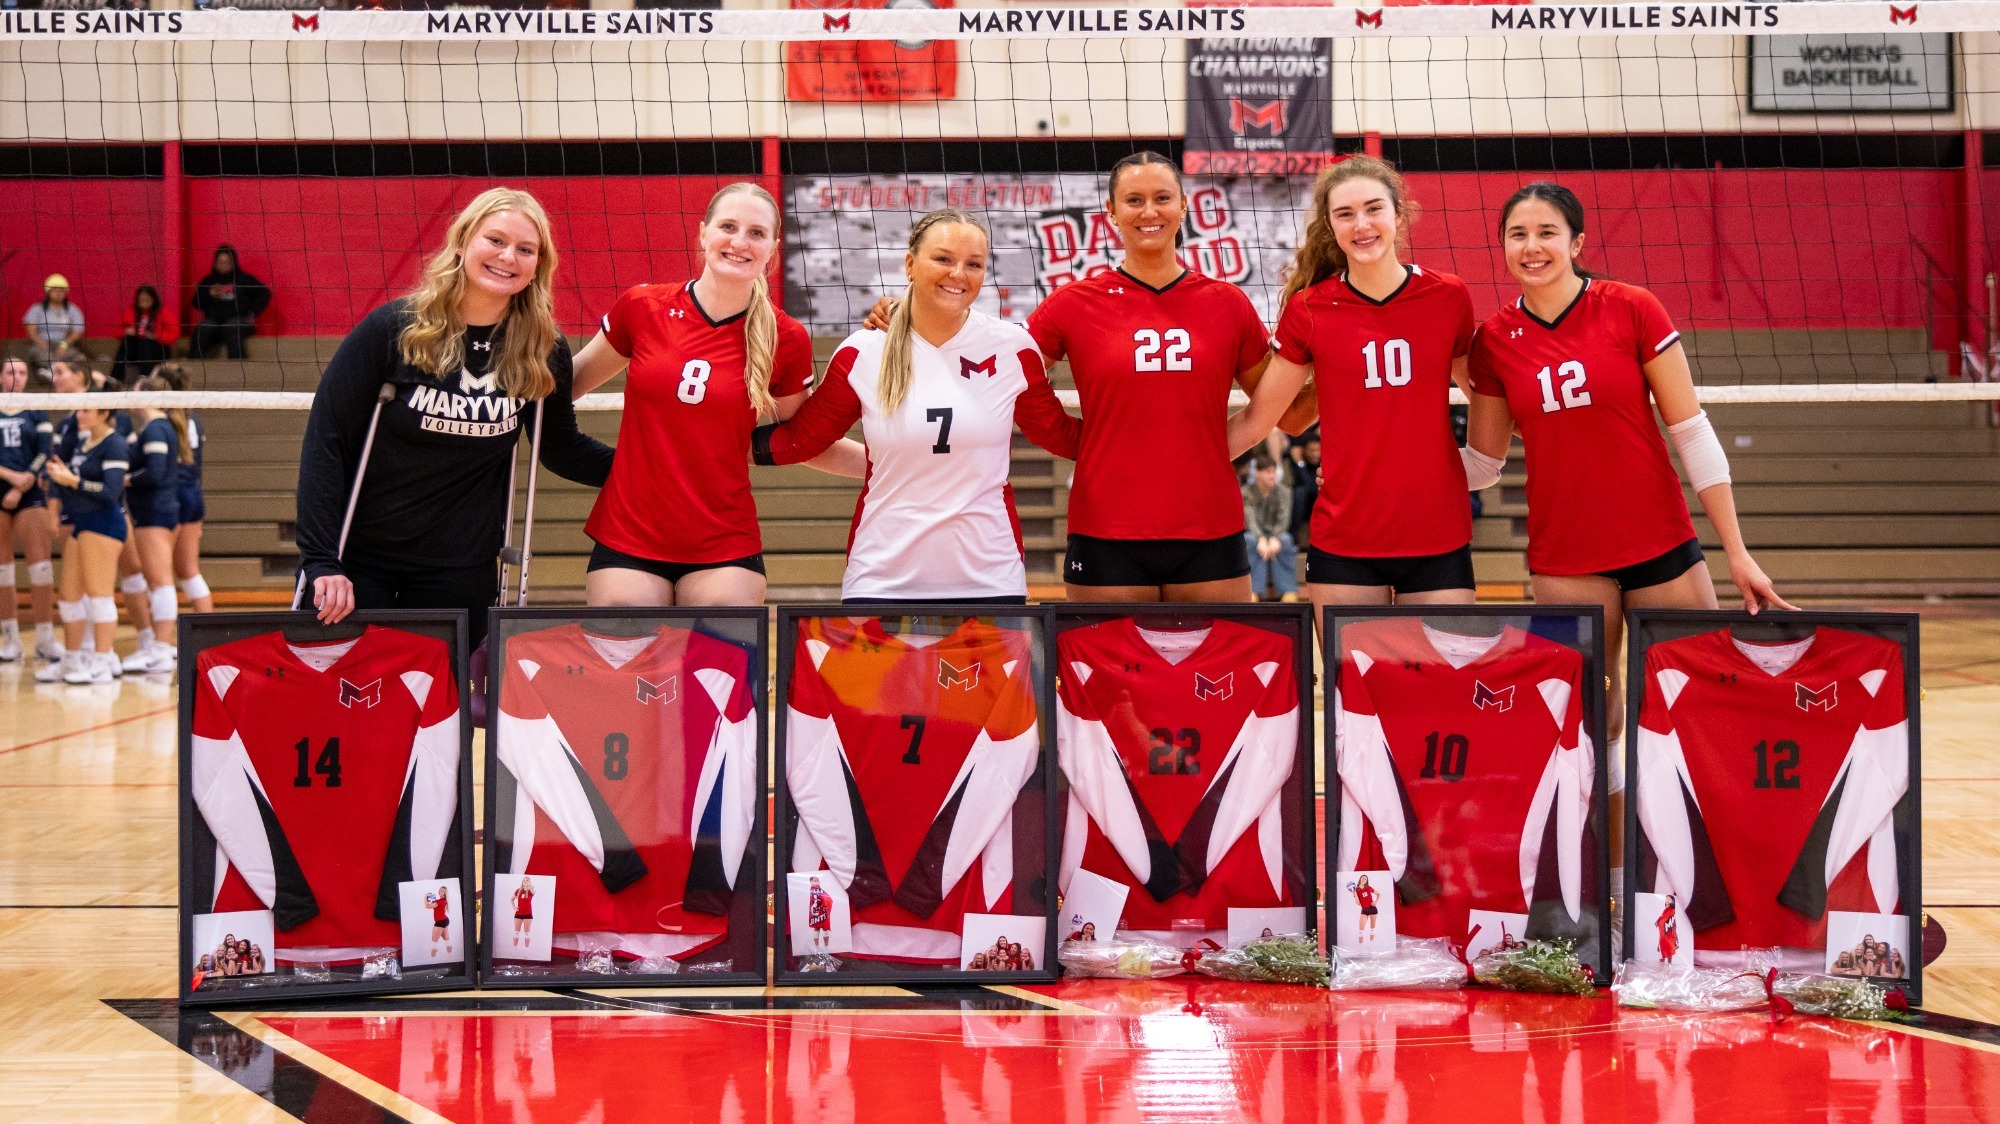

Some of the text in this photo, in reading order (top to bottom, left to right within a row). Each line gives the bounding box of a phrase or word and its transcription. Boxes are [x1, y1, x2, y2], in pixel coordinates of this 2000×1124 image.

[76, 12, 183, 33] SAINTS
[428, 12, 714, 33] MARYVILLE SAINTS
[959, 9, 1245, 32] MARYVILLE SAINTS
[1491, 5, 1779, 29] MARYVILLE SAINTS
[1202, 37, 1316, 52] NATIONAL
[1800, 45, 1901, 64] WOMEN'S
[1189, 55, 1329, 77] CHAMPIONS
[1782, 68, 1918, 86] BASKETBALL
[1223, 82, 1298, 95] MARYVILLE
[1197, 155, 1322, 175] 2020-2021
[819, 184, 1053, 208] STUDENT SECTION
[1133, 328, 1192, 372] 22
[1361, 337, 1412, 389] 10
[676, 358, 712, 405] 8
[1536, 360, 1592, 413] 12
[3, 427, 22, 448] 12
[423, 417, 517, 435] VOLLEYBALL
[926, 407, 953, 454] 7
[900, 714, 926, 765] 7
[1148, 728, 1201, 775] 22
[294, 737, 342, 787] 14
[603, 732, 629, 781] 8
[1420, 731, 1470, 782] 10
[1752, 740, 1801, 789] 12
